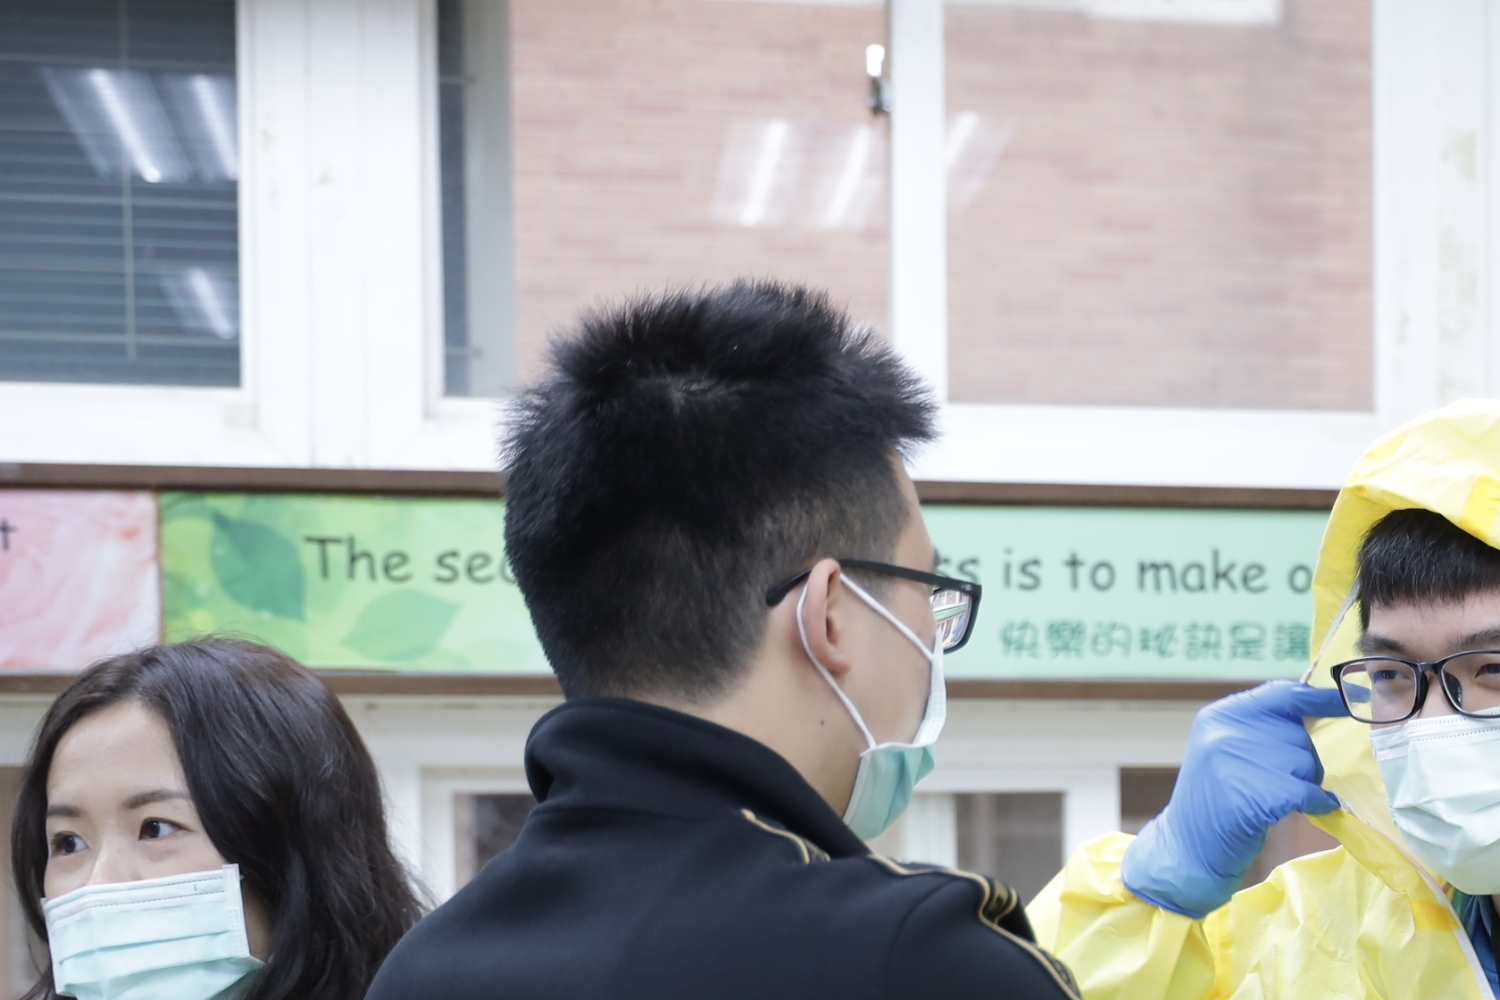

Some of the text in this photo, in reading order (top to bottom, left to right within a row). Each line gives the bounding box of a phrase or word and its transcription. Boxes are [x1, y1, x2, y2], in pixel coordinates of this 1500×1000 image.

[305, 535, 412, 583] The
[1002, 548, 1042, 592] is
[1062, 551, 1116, 593] to
[1137, 548, 1270, 594] make
